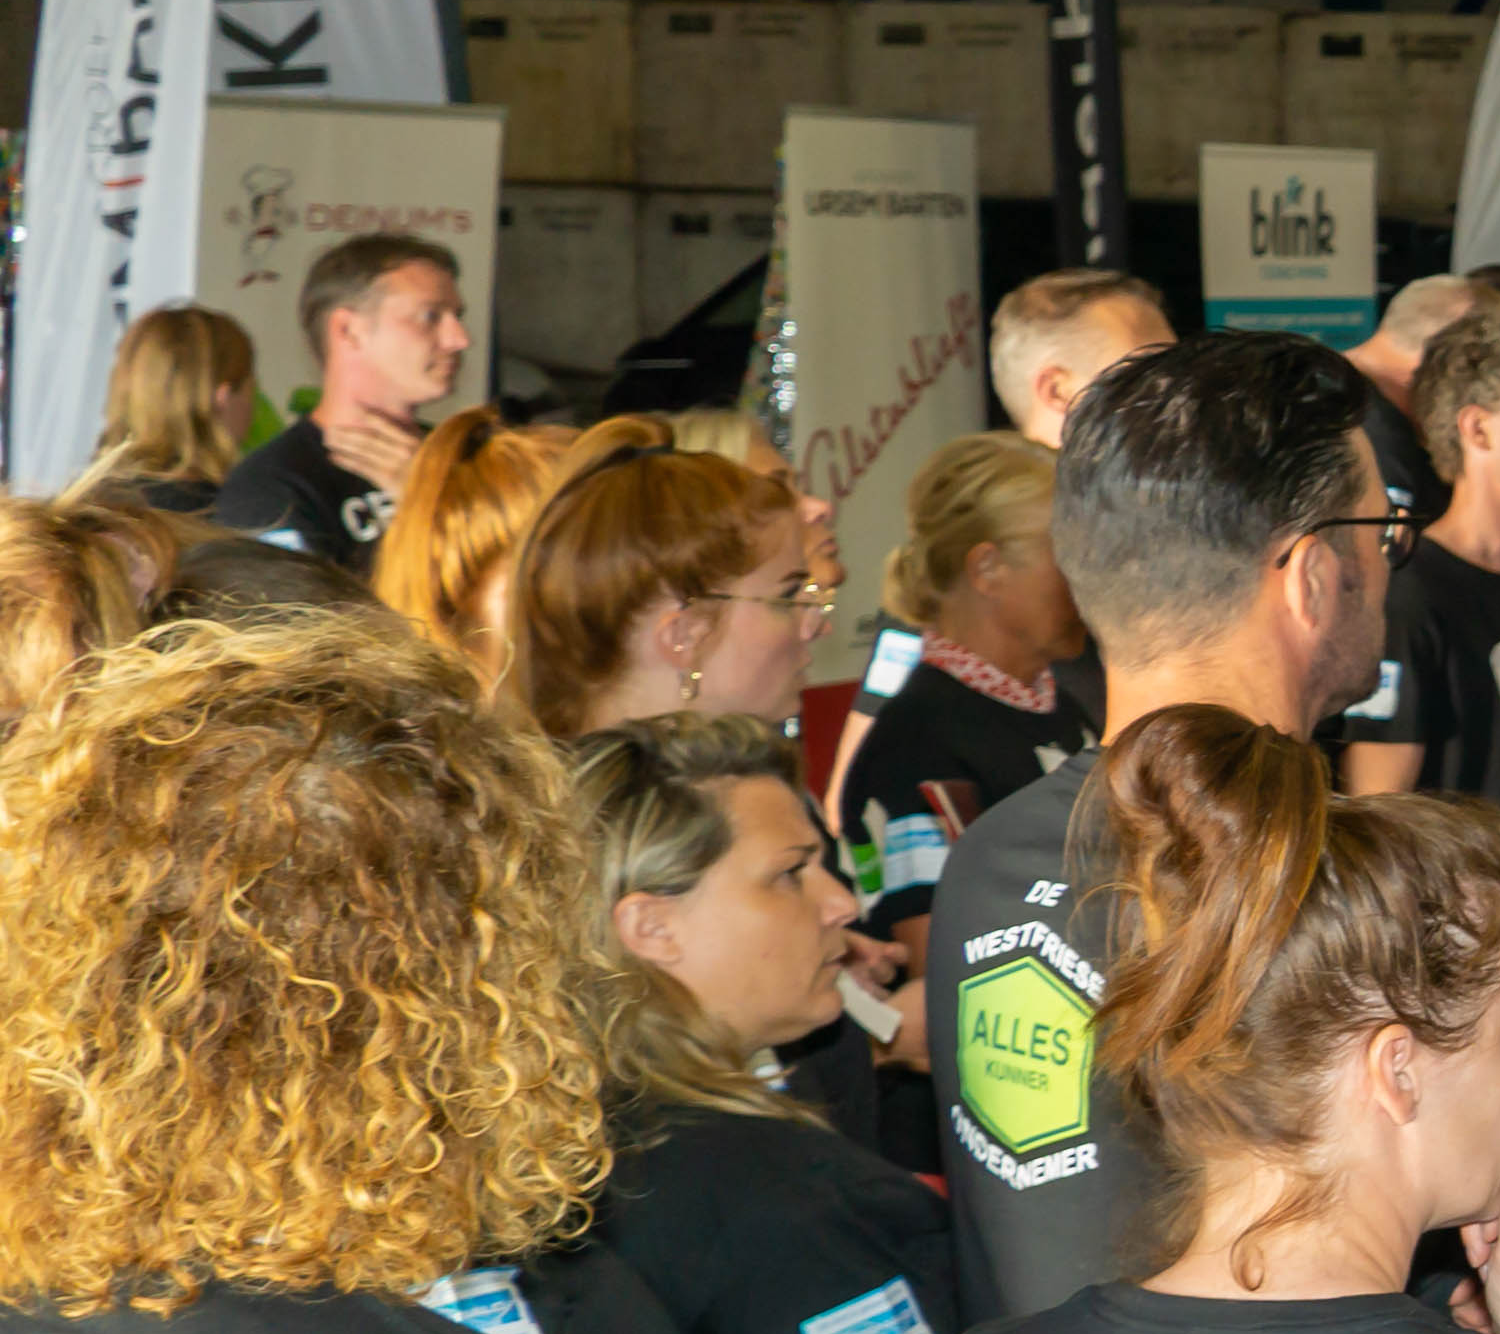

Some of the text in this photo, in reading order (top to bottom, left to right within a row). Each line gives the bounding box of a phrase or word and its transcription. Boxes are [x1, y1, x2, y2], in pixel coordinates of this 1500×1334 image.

[1250, 185, 1336, 258] blink
[1023, 880, 1068, 909] DE
[964, 920, 1106, 1002] WESTFRIESE
[972, 1008, 1072, 1068] ALLES
[984, 1060, 1049, 1093] KUNNER
